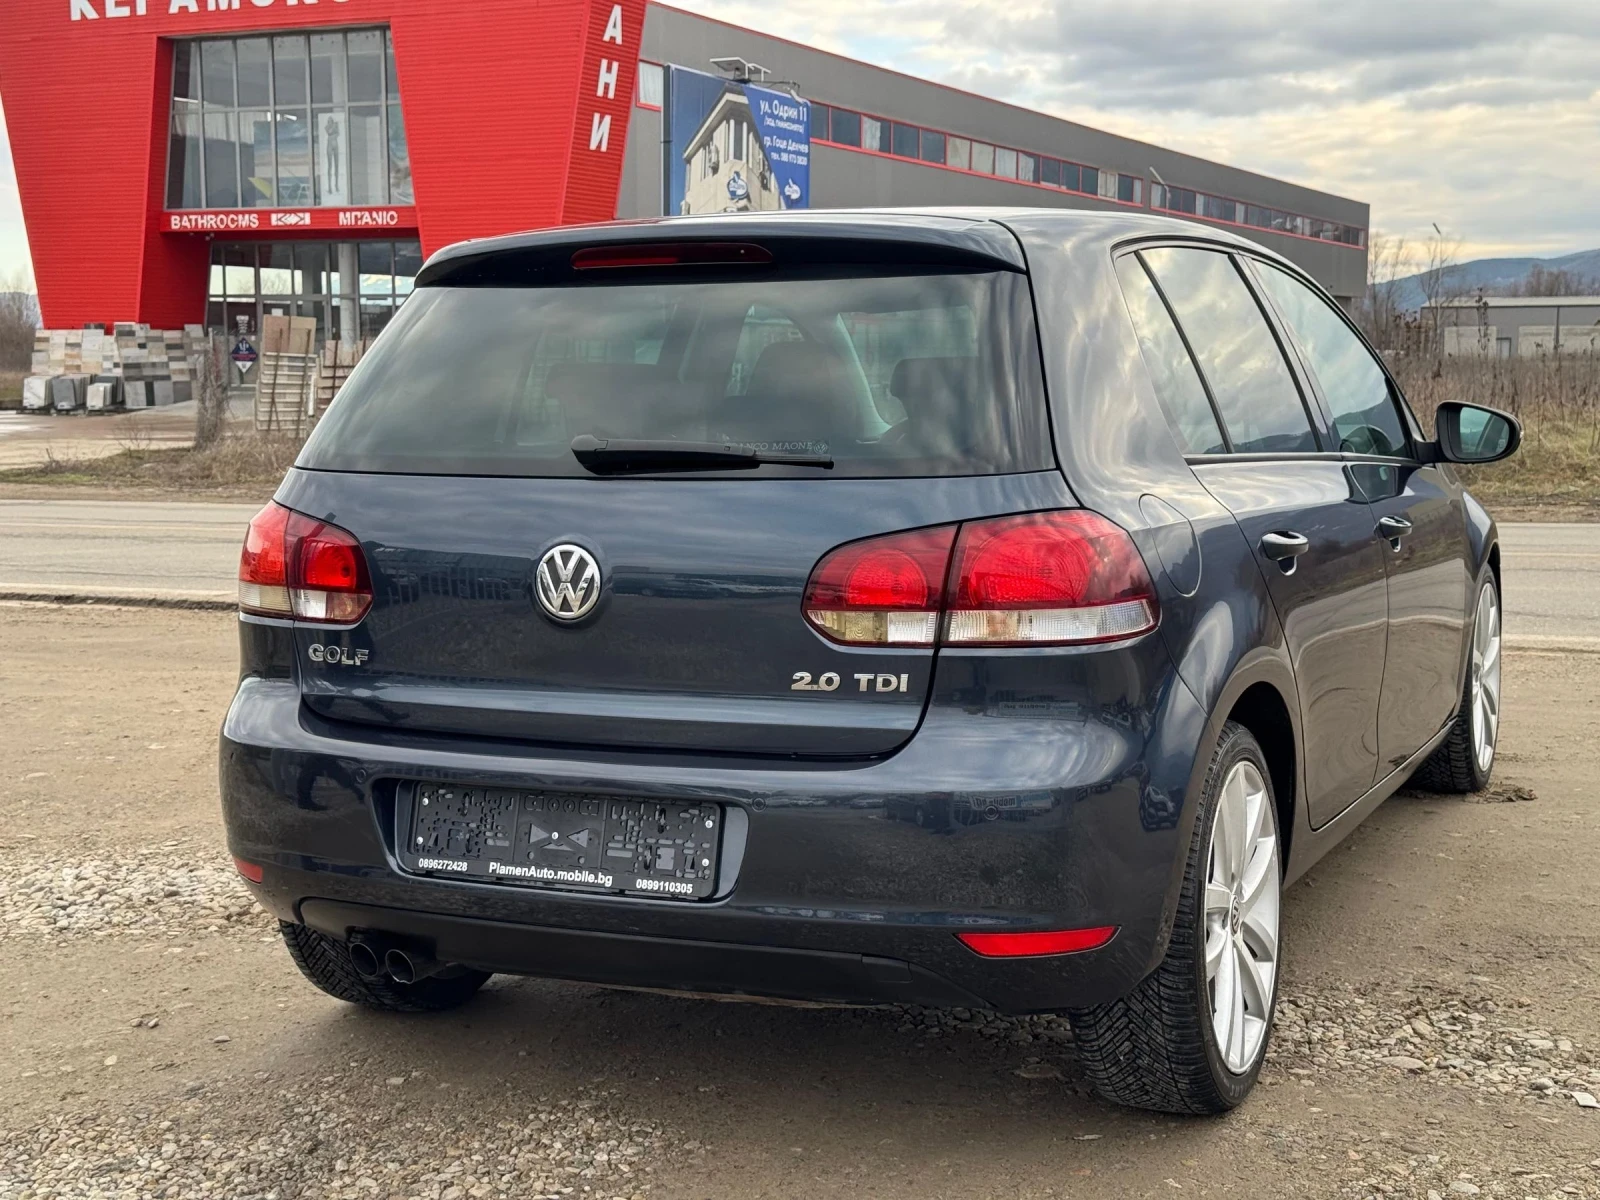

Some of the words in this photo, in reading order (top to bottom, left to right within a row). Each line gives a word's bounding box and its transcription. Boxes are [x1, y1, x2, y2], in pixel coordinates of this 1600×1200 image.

[799, 106, 807, 122] 11
[535, 543, 602, 620] VW
[308, 643, 369, 666] GOLF
[790, 671, 841, 692] 2.0
[853, 672, 910, 693] TDI
[418, 858, 468, 872] 0896272428
[488, 861, 613, 887] PlamenAuto.mobile.bg
[635, 878, 693, 894] 0899110305
